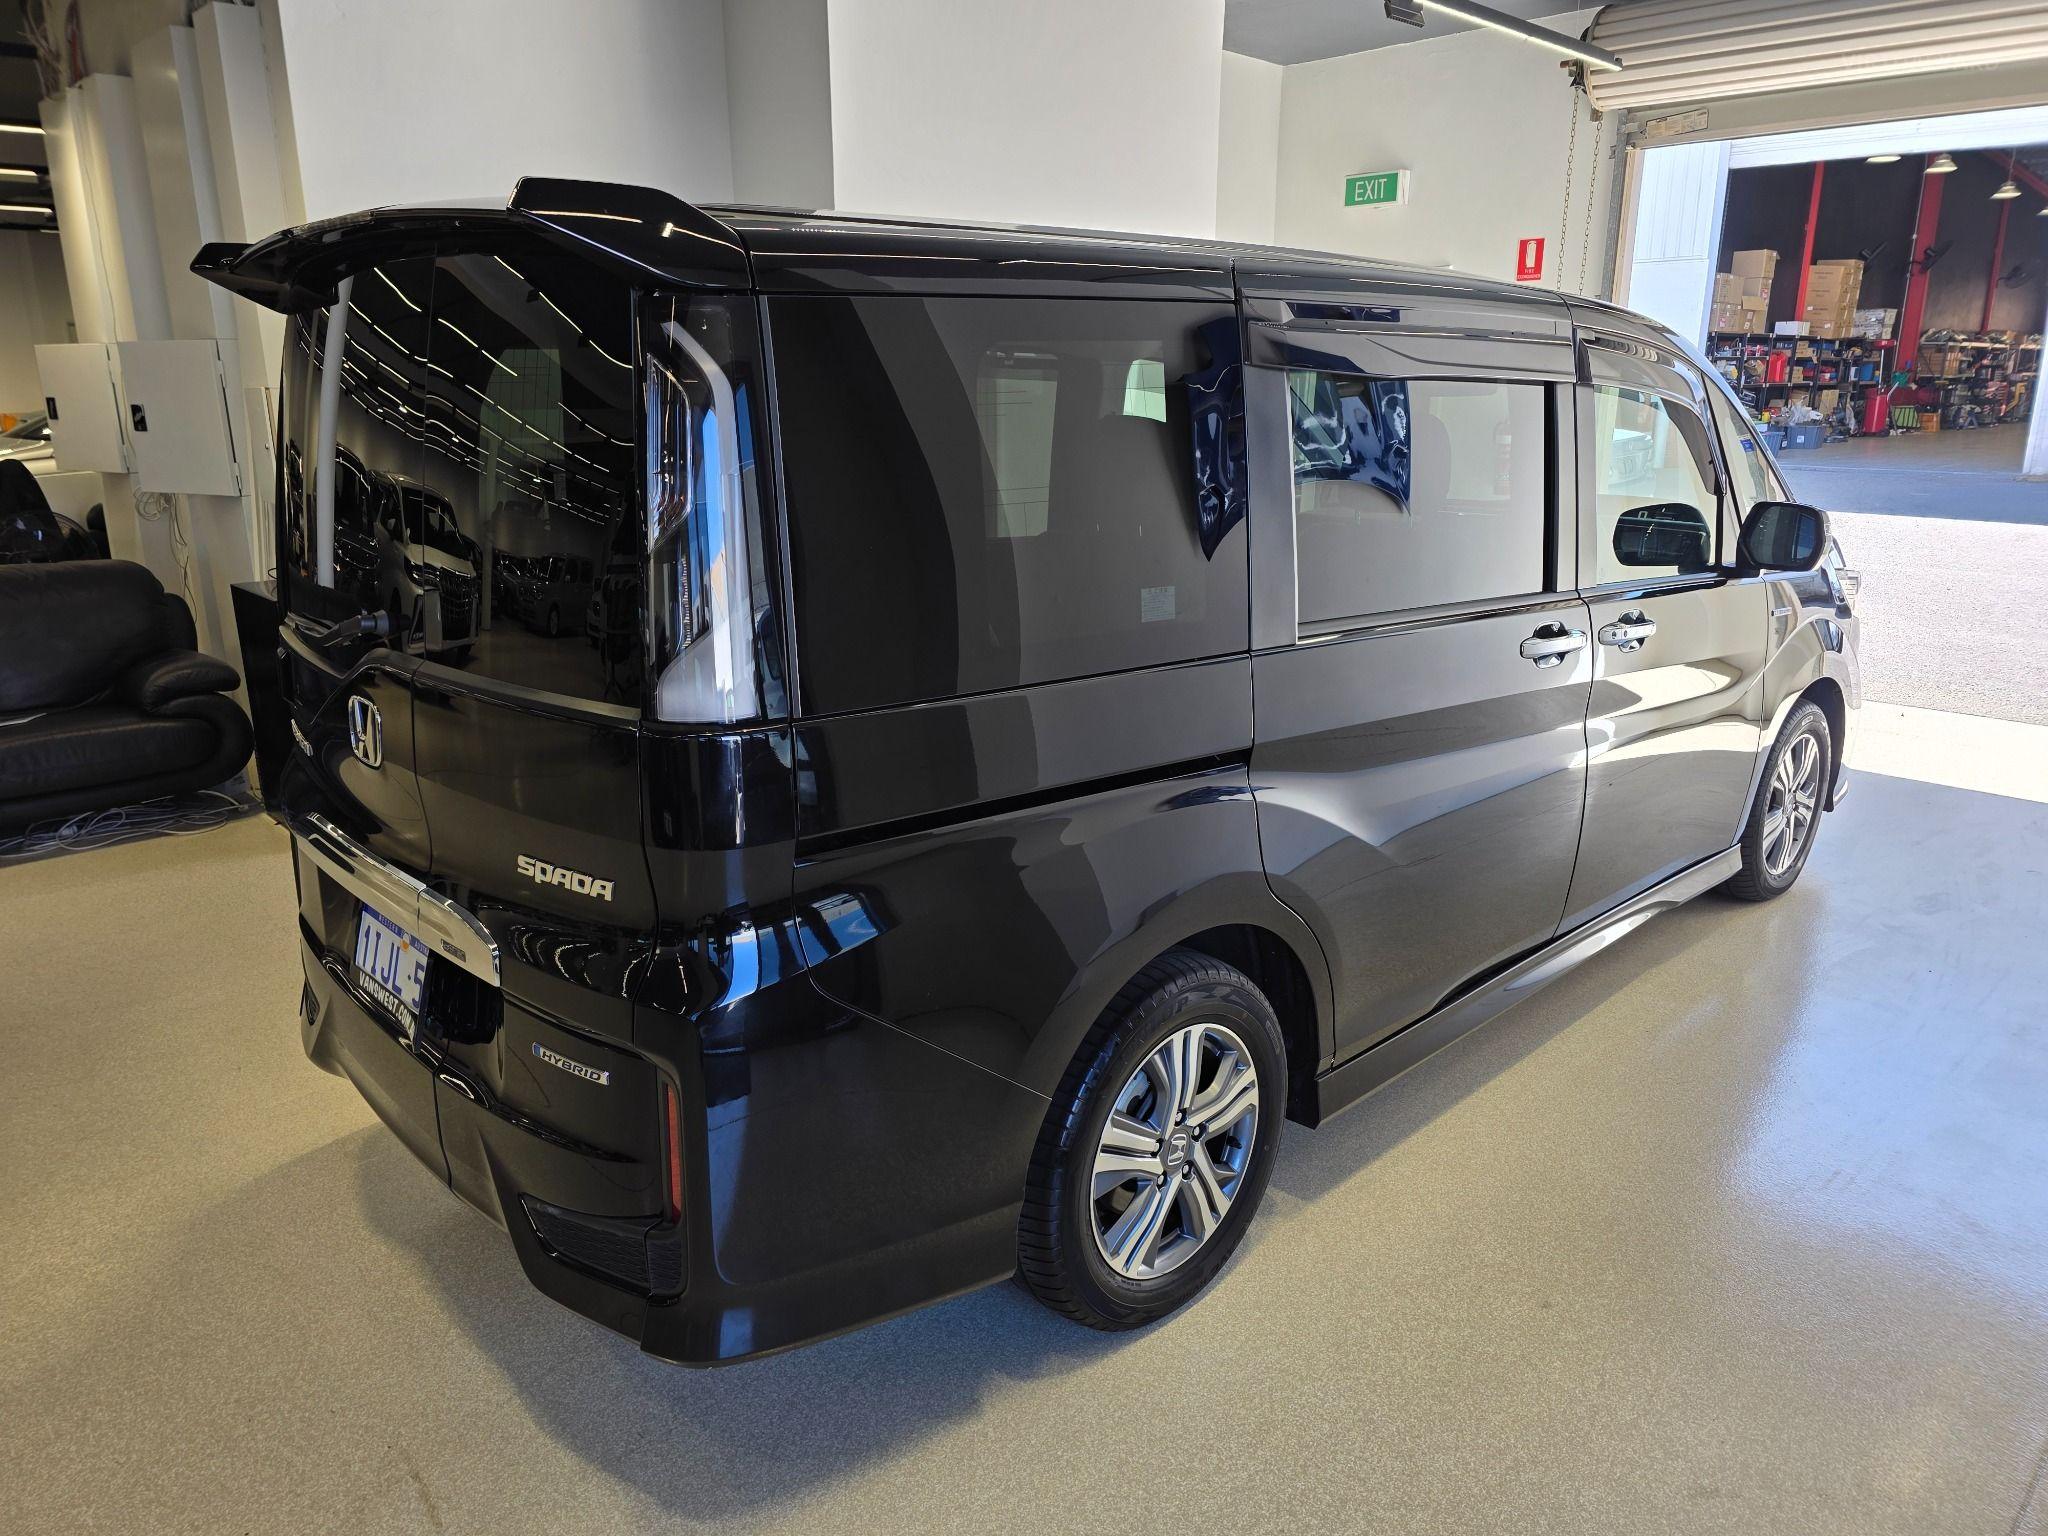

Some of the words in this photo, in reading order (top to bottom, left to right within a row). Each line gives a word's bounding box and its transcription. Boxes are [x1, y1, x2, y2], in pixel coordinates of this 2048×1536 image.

[1355, 179, 1387, 201] EXIT
[517, 854, 615, 901] SPADA
[542, 1051, 601, 1081] HYBRID
